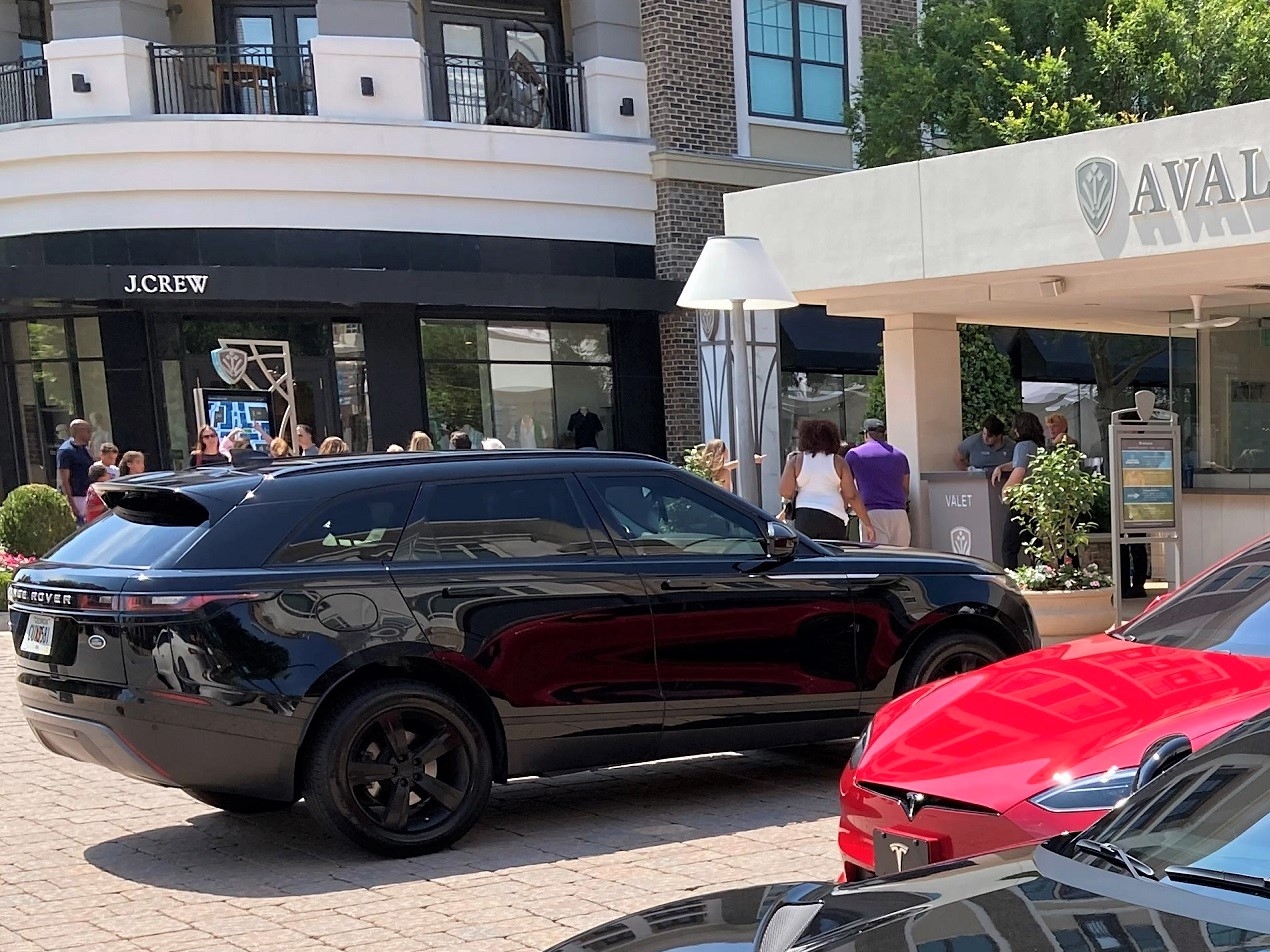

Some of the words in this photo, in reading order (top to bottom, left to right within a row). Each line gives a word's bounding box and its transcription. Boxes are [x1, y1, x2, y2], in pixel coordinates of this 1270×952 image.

[124, 274, 209, 294] J.CREW
[945, 494, 973, 507] VALET
[31, 591, 71, 604] ROVER
